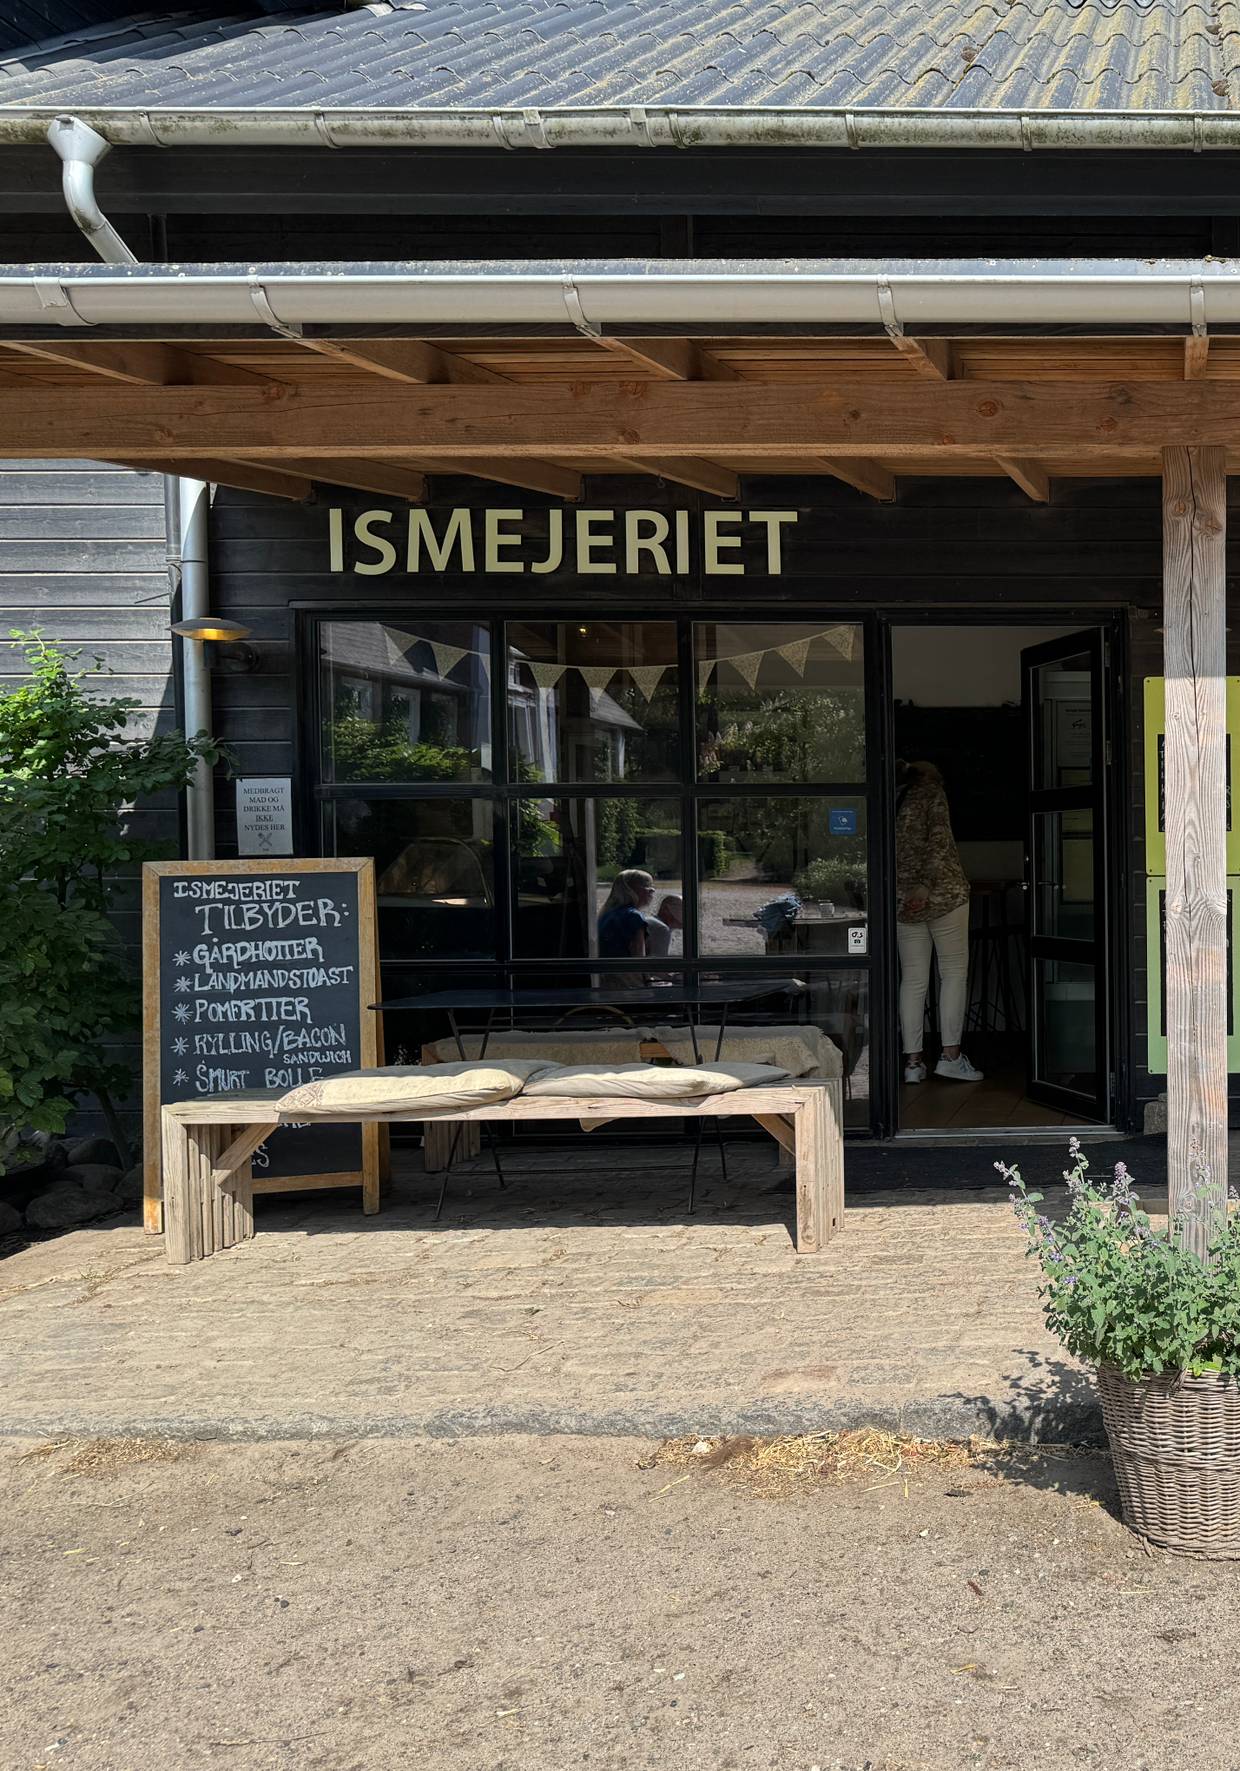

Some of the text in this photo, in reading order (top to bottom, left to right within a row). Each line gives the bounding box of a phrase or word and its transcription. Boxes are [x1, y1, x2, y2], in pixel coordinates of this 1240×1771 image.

[330, 508, 798, 575] ISMEJERIET
[270, 823, 285, 831] HER
[173, 880, 300, 900] ISMEJERIET
[195, 898, 350, 935] TILBYDER:
[194, 966, 354, 993] LANDMANDSTOAST
[283, 1050, 352, 1065] SANDWICH
